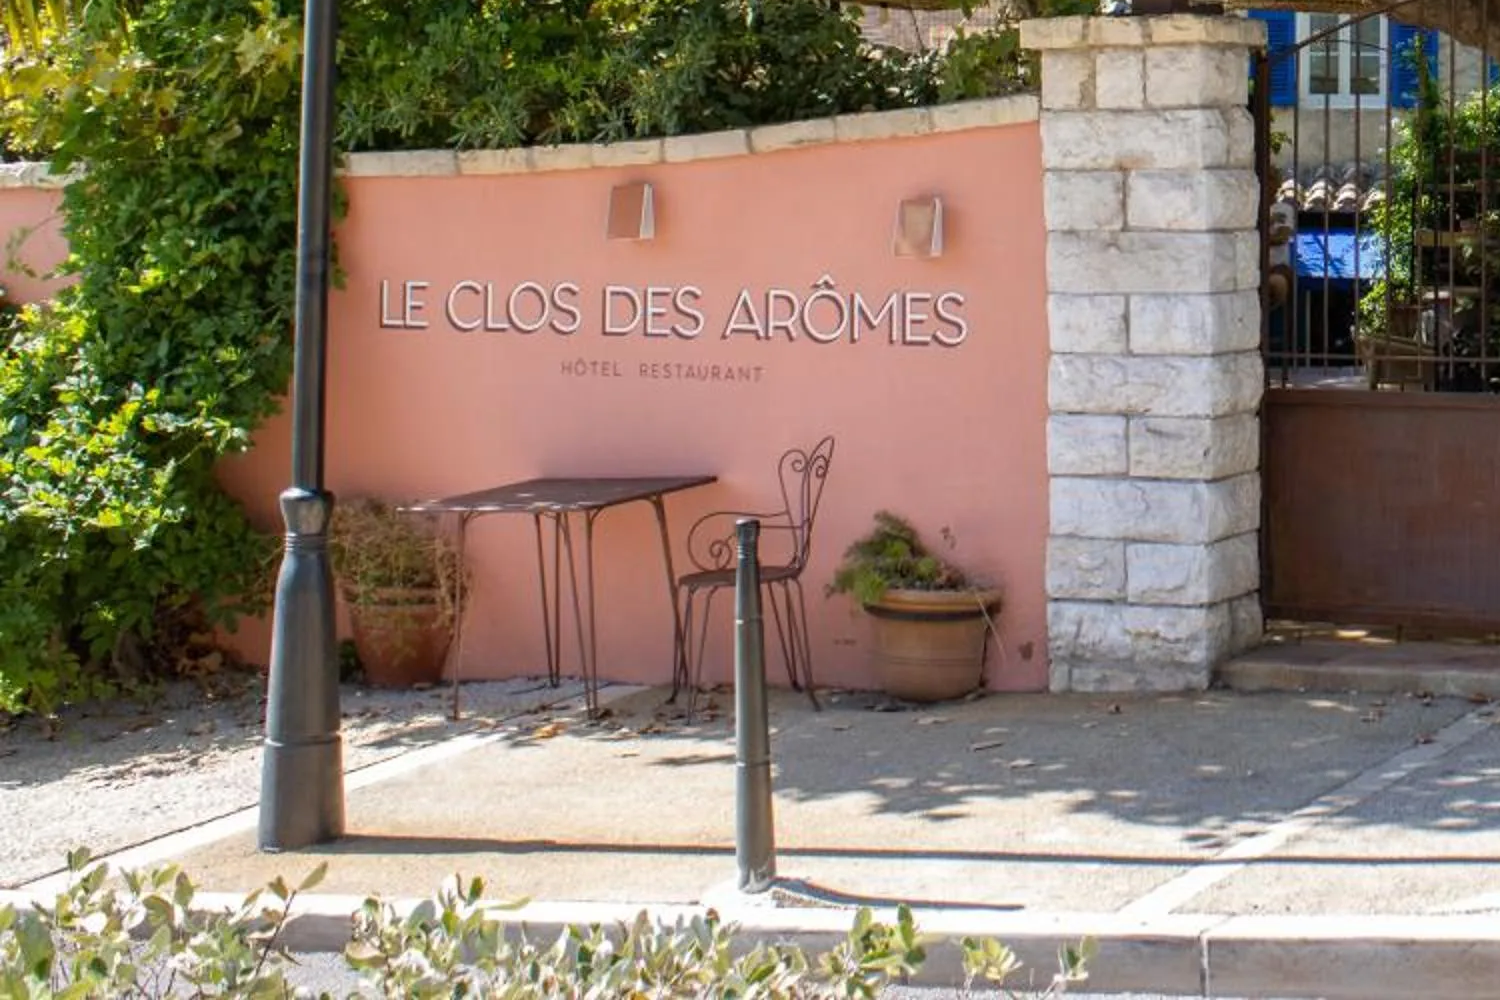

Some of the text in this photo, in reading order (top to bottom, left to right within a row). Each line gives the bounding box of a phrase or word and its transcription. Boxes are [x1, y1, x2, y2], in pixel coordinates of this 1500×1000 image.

[380, 274, 968, 348] LE CLOS DES ARÔMES
[560, 357, 764, 383] HÔTEL RESTAURANT
